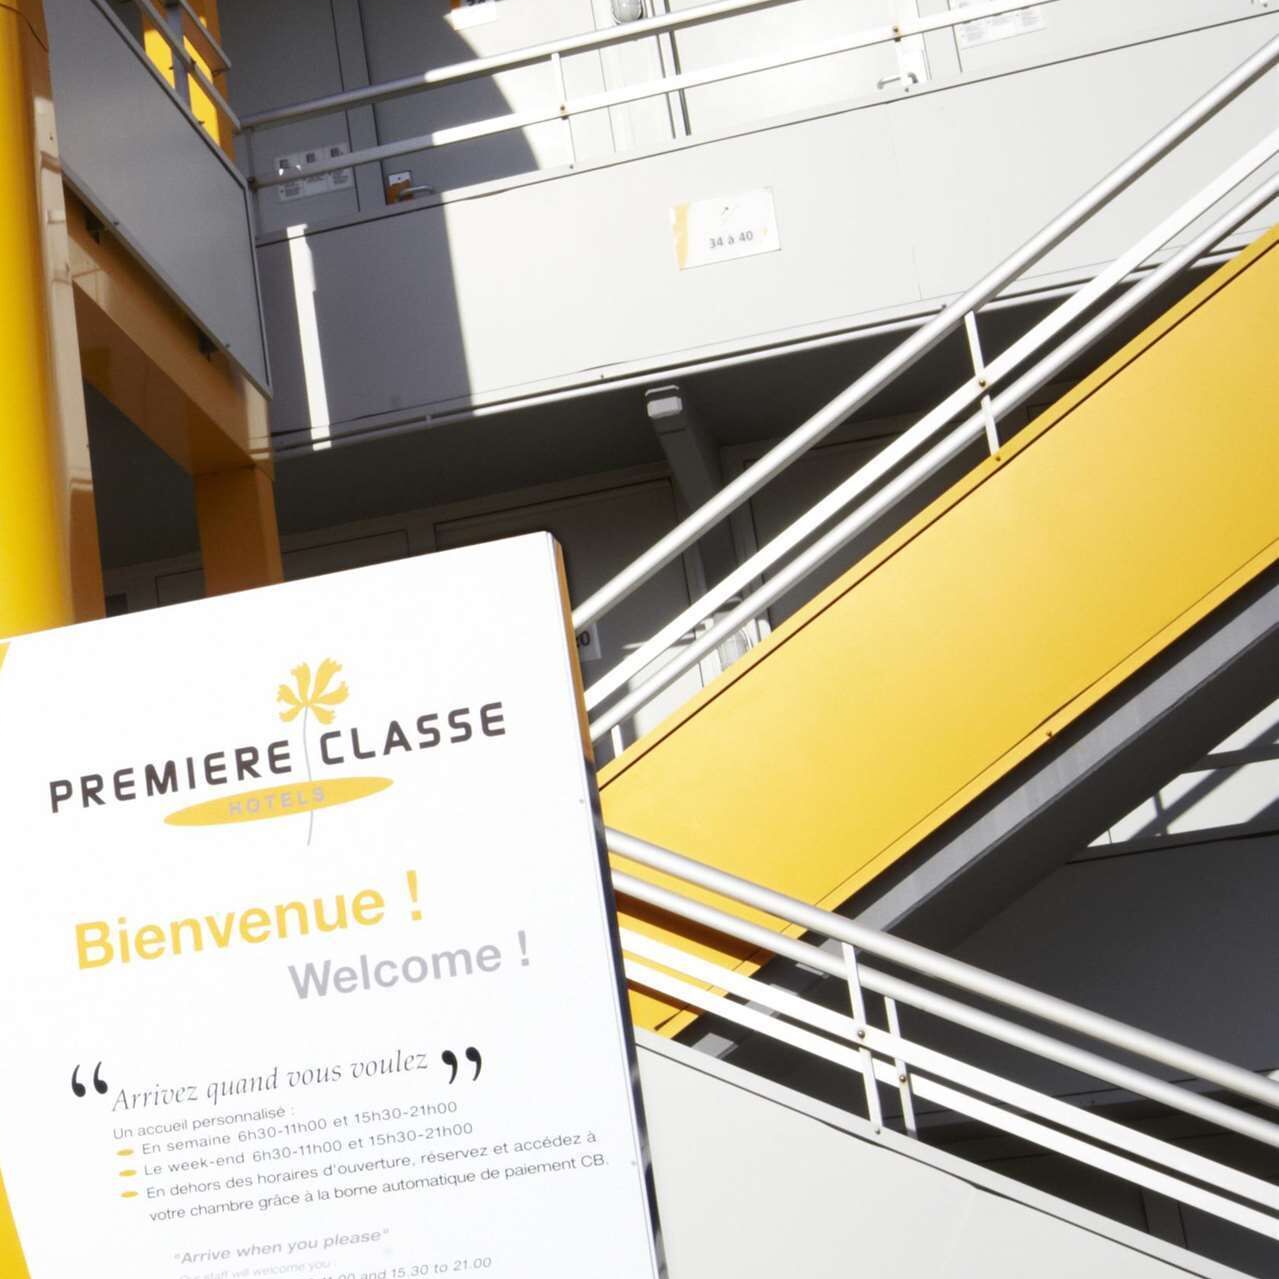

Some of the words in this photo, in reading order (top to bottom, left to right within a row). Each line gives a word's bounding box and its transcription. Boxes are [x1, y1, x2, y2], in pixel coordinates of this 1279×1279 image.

[708, 237, 725, 249] 34
[738, 229, 754, 242] 40
[48, 739, 292, 814] PREMIERE
[319, 701, 506, 765] CLASSE
[227, 786, 327, 818] HOTELS
[75, 889, 385, 969] Bienvenue
[405, 869, 422, 921] !
[286, 944, 501, 999] Welcome
[517, 929, 529, 967] !
[111, 1083, 198, 1112] Arrivez
[206, 1065, 277, 1106] quand
[286, 1064, 342, 1087] vous
[350, 1048, 428, 1079] voulez
[112, 1127, 133, 1140] Un
[136, 1119, 187, 1136] accueil
[191, 1106, 286, 1131] personnalisé
[141, 1142, 161, 1155] En
[166, 1134, 231, 1152] semaine
[237, 1117, 327, 1142] 6h30-11h00
[332, 1114, 348, 1128] et
[353, 1100, 457, 1123] 15h30-21h00
[143, 1164, 162, 1176] Le
[167, 1151, 245, 1172] week-end
[252, 1139, 342, 1162] 6h30-11h00
[347, 1137, 363, 1150] et
[368, 1121, 473, 1146] 15h30-21h00
[145, 1185, 165, 1199] En
[169, 1180, 221, 1196] dehors
[224, 1176, 253, 1189] des
[256, 1168, 318, 1184] horaires
[420, 1146, 488, 1163] réservez
[492, 1142, 509, 1155] et
[513, 1134, 581, 1152] accédez
[586, 1131, 597, 1143] à
[148, 1208, 185, 1221] votre
[189, 1199, 254, 1216] chambre
[257, 1193, 300, 1211] grâce
[303, 1191, 313, 1202] à
[316, 1189, 330, 1200] la
[333, 1184, 377, 1198] borne
[381, 1171, 476, 1192] automatique
[479, 1167, 500, 1180] de
[503, 1157, 576, 1180] paiement
[580, 1152, 610, 1167] CB.
[235, 1243, 282, 1257] when
[287, 1239, 318, 1254] you
